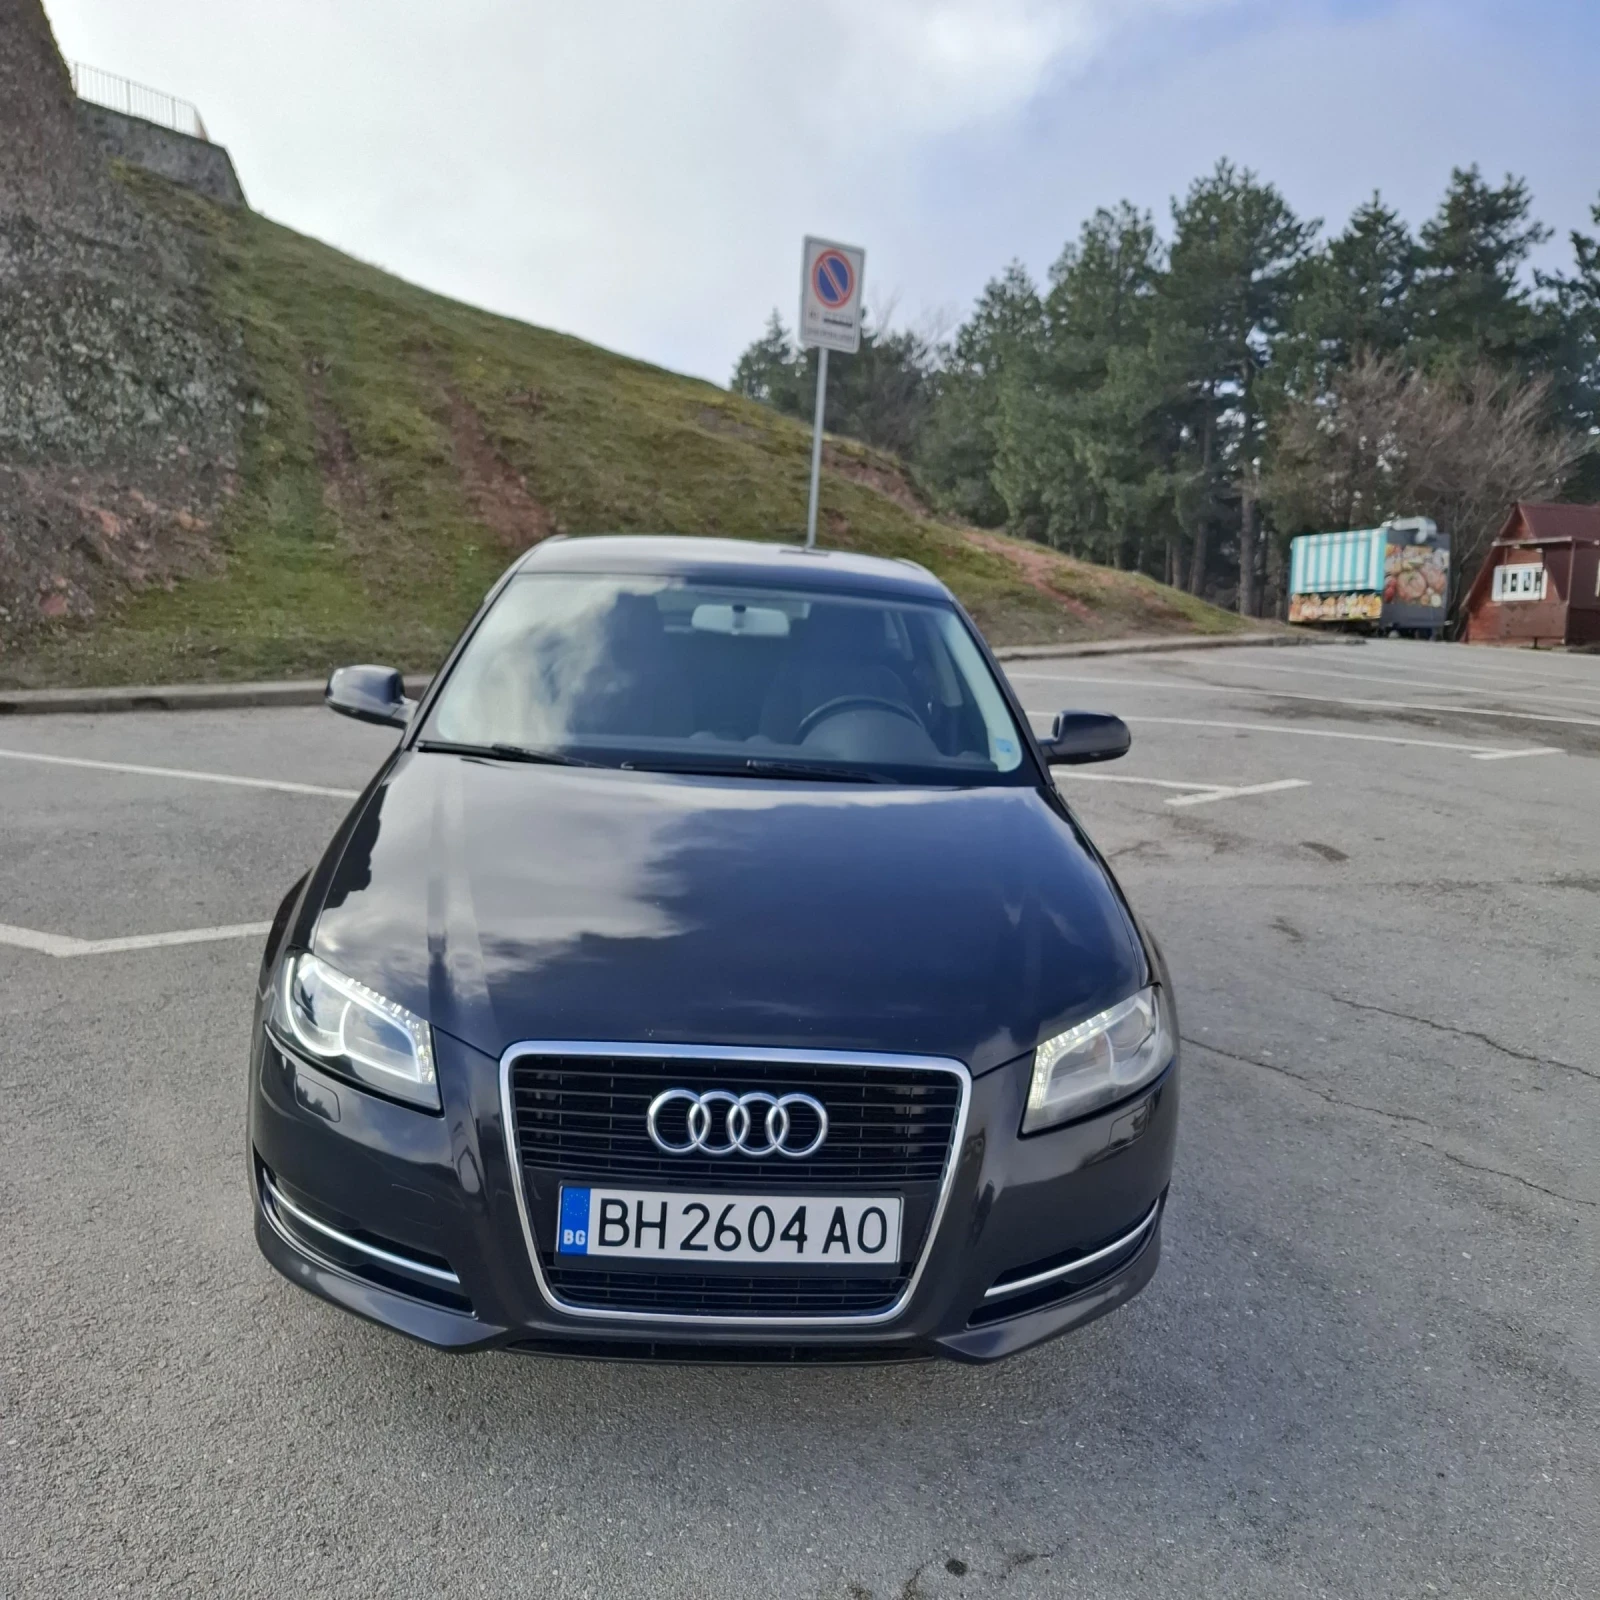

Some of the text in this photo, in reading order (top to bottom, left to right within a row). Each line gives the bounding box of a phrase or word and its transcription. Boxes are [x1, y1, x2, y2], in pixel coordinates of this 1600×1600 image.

[563, 1228, 586, 1246] BG
[598, 1197, 889, 1255] BH 2604 AO
